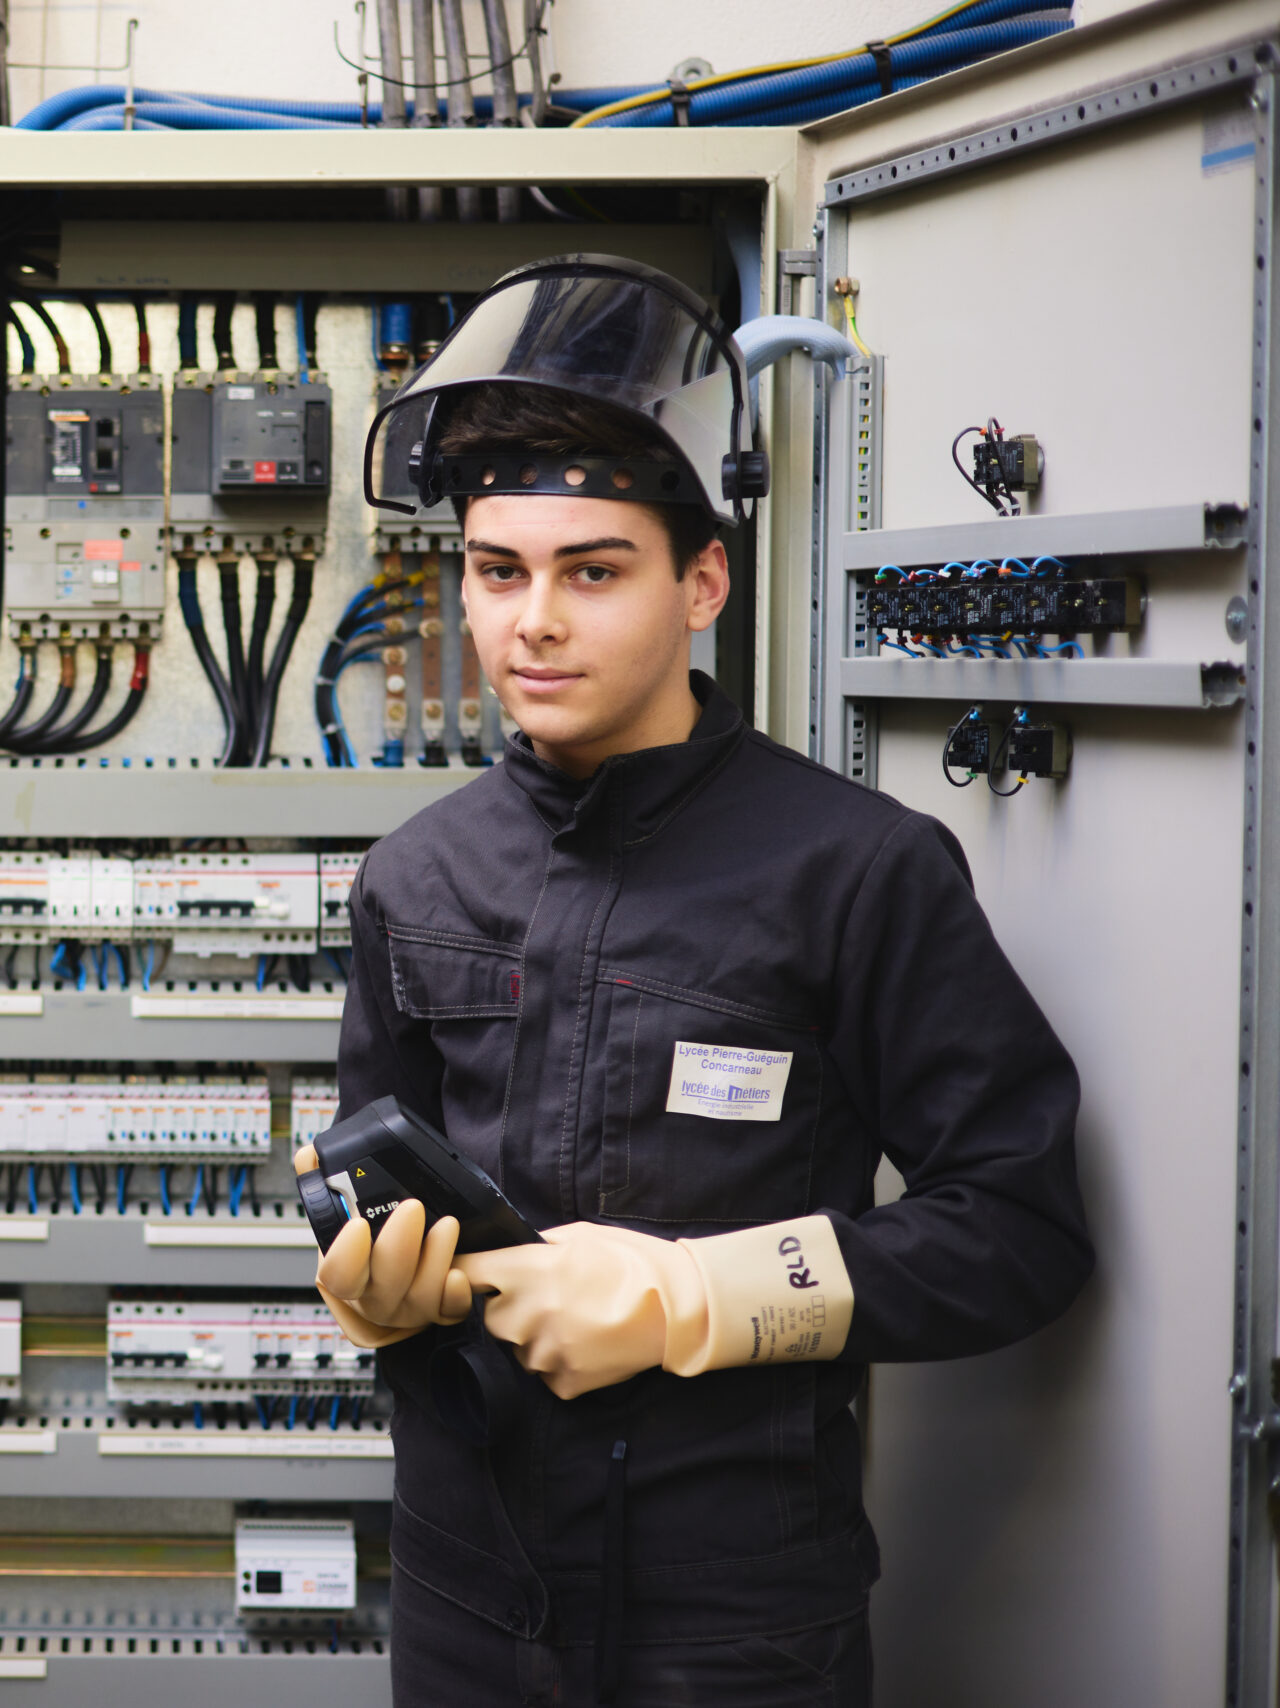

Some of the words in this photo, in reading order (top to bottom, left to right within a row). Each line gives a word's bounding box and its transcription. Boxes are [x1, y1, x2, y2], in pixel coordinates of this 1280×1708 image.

[679, 1044, 709, 1057] Lycée
[712, 1047, 788, 1066] Pierre-Guéguin
[701, 1058, 762, 1075] Concarneau
[681, 1079, 710, 1097] lycée
[711, 1084, 726, 1098] des
[374, 1200, 399, 1215] FLIR
[778, 1236, 819, 1289] RLD
[750, 1316, 762, 1360] Honeywell
